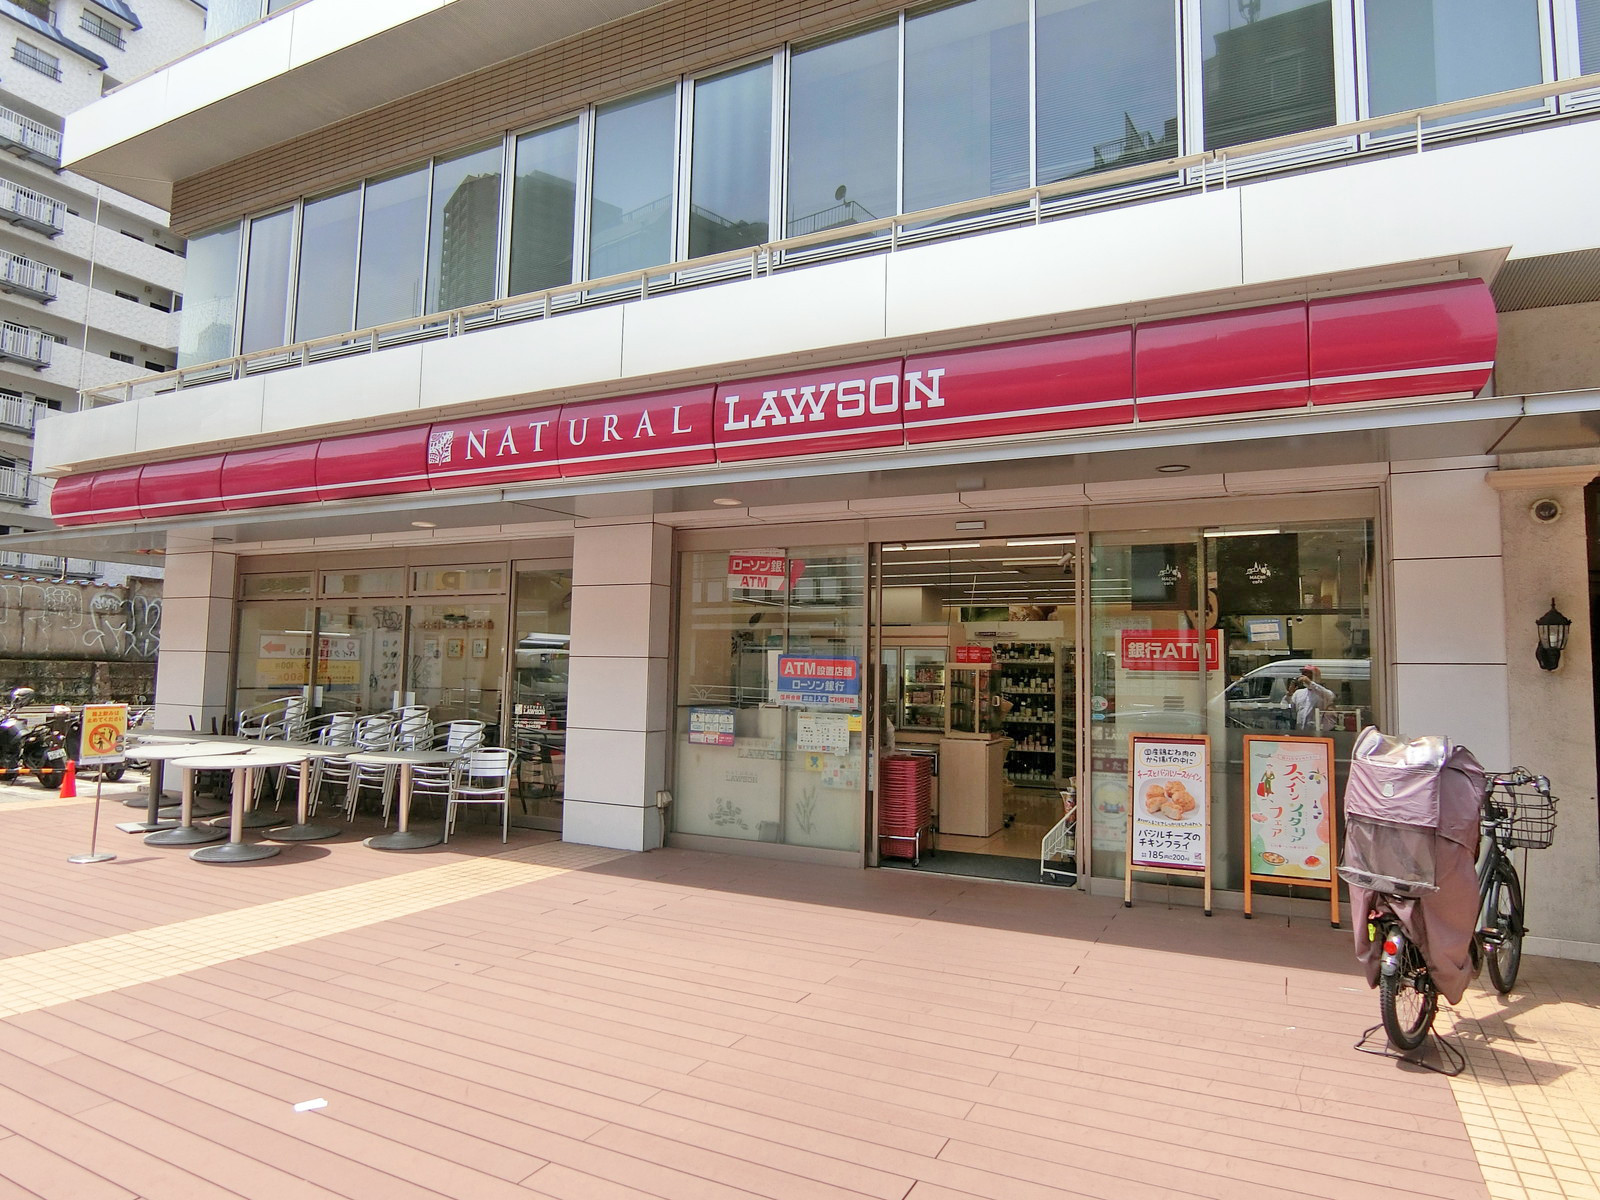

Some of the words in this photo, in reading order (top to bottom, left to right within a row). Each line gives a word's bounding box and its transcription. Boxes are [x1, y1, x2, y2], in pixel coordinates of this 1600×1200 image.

[465, 405, 692, 461] NATURAL
[723, 368, 946, 432] LAWSON
[740, 575, 769, 588] ATM
[1128, 642, 1212, 660] 銀行ATM
[784, 661, 853, 677] ATM設置店舗
[792, 680, 845, 692] ローソン銀行
[1144, 748, 1197, 757] 国産鶏むね肉の
[1146, 756, 1194, 765] から揚げの中に
[1283, 763, 1306, 801] スペイン
[1269, 806, 1283, 837] フェア
[1289, 803, 1306, 842] イタリア
[1138, 830, 1201, 841] バジルチーズの
[1139, 838, 1190, 850] チキンフライ
